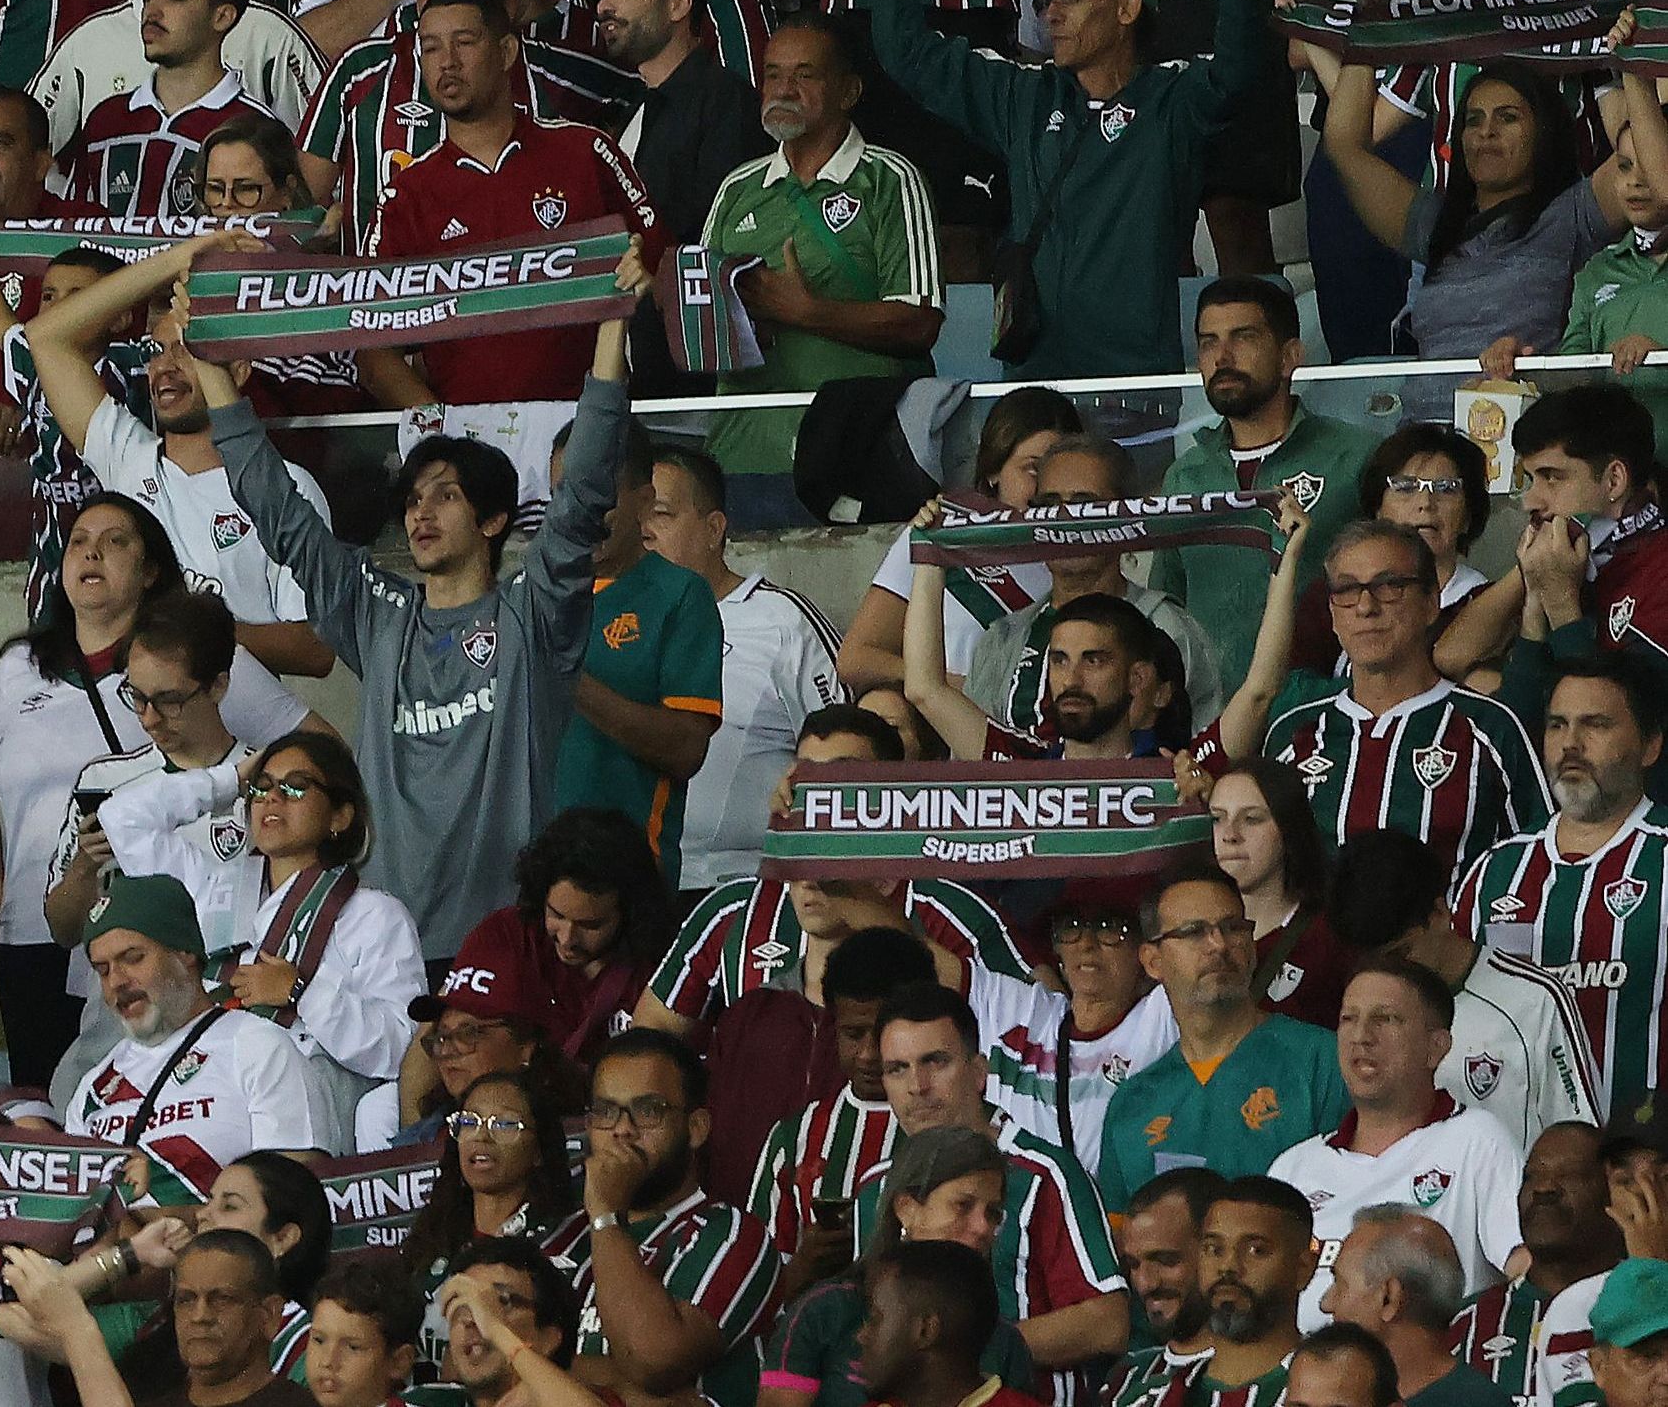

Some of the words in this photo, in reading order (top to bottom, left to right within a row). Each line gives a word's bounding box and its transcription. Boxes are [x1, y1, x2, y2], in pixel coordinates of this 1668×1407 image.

[1501, 5, 1597, 32] SUPERBET
[395, 117, 430, 126] umbro
[236, 258, 513, 312] FLUMINENSE
[520, 247, 578, 282] FC
[350, 299, 459, 330] SUPERBET
[803, 785, 1089, 829] FLUMINENSE
[1097, 786, 1156, 825] FC
[922, 836, 1036, 863] SUPERBET
